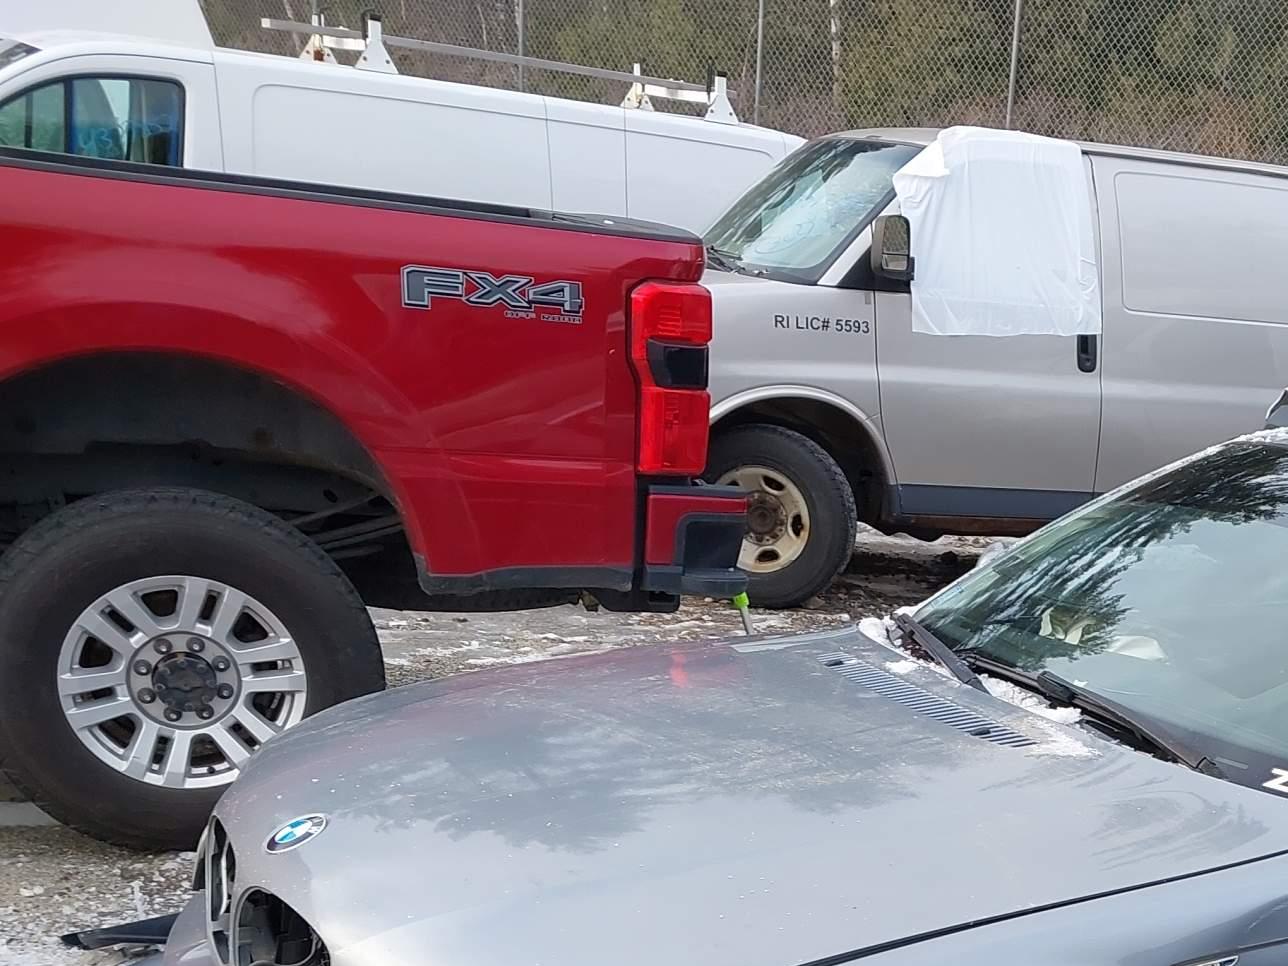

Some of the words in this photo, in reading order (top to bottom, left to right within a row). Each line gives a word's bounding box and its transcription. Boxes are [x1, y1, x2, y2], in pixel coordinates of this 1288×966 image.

[401, 264, 584, 316] FX4
[774, 314, 790, 329] RI
[795, 315, 831, 331] LIC#
[835, 318, 870, 334] 5593
